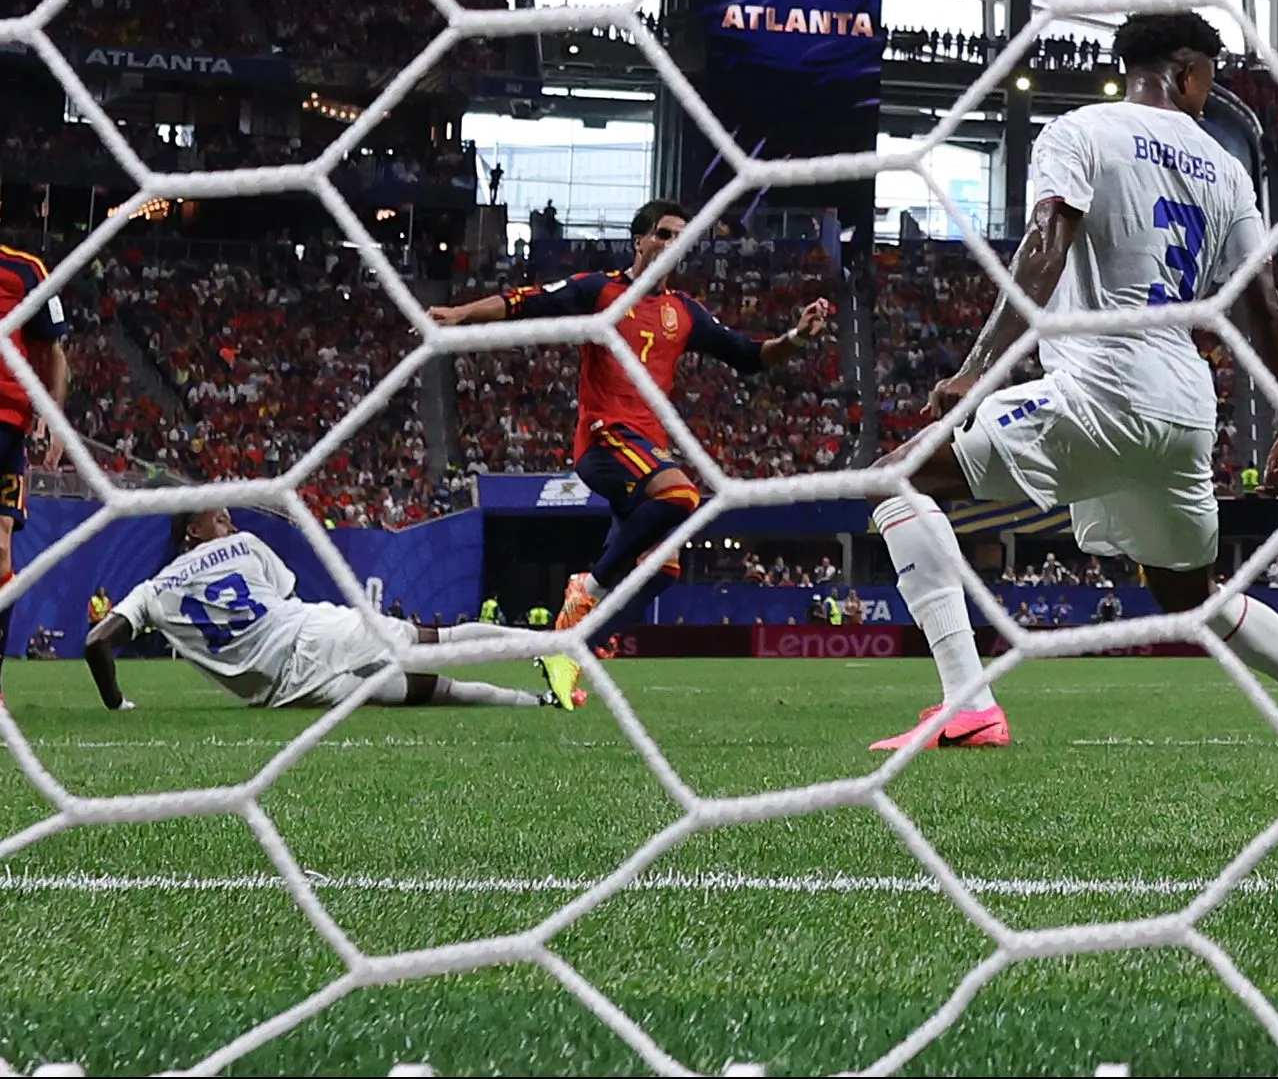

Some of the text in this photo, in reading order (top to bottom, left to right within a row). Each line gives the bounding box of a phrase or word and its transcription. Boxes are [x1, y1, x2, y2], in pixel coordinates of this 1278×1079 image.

[721, 3, 874, 38] ATLANTA
[86, 48, 234, 74] ATLANTA
[1134, 135, 1217, 184] BORGES
[1147, 196, 1207, 306] 3
[639, 330, 655, 363] 7
[179, 572, 269, 655] 13
[758, 627, 895, 657] Lenovo
